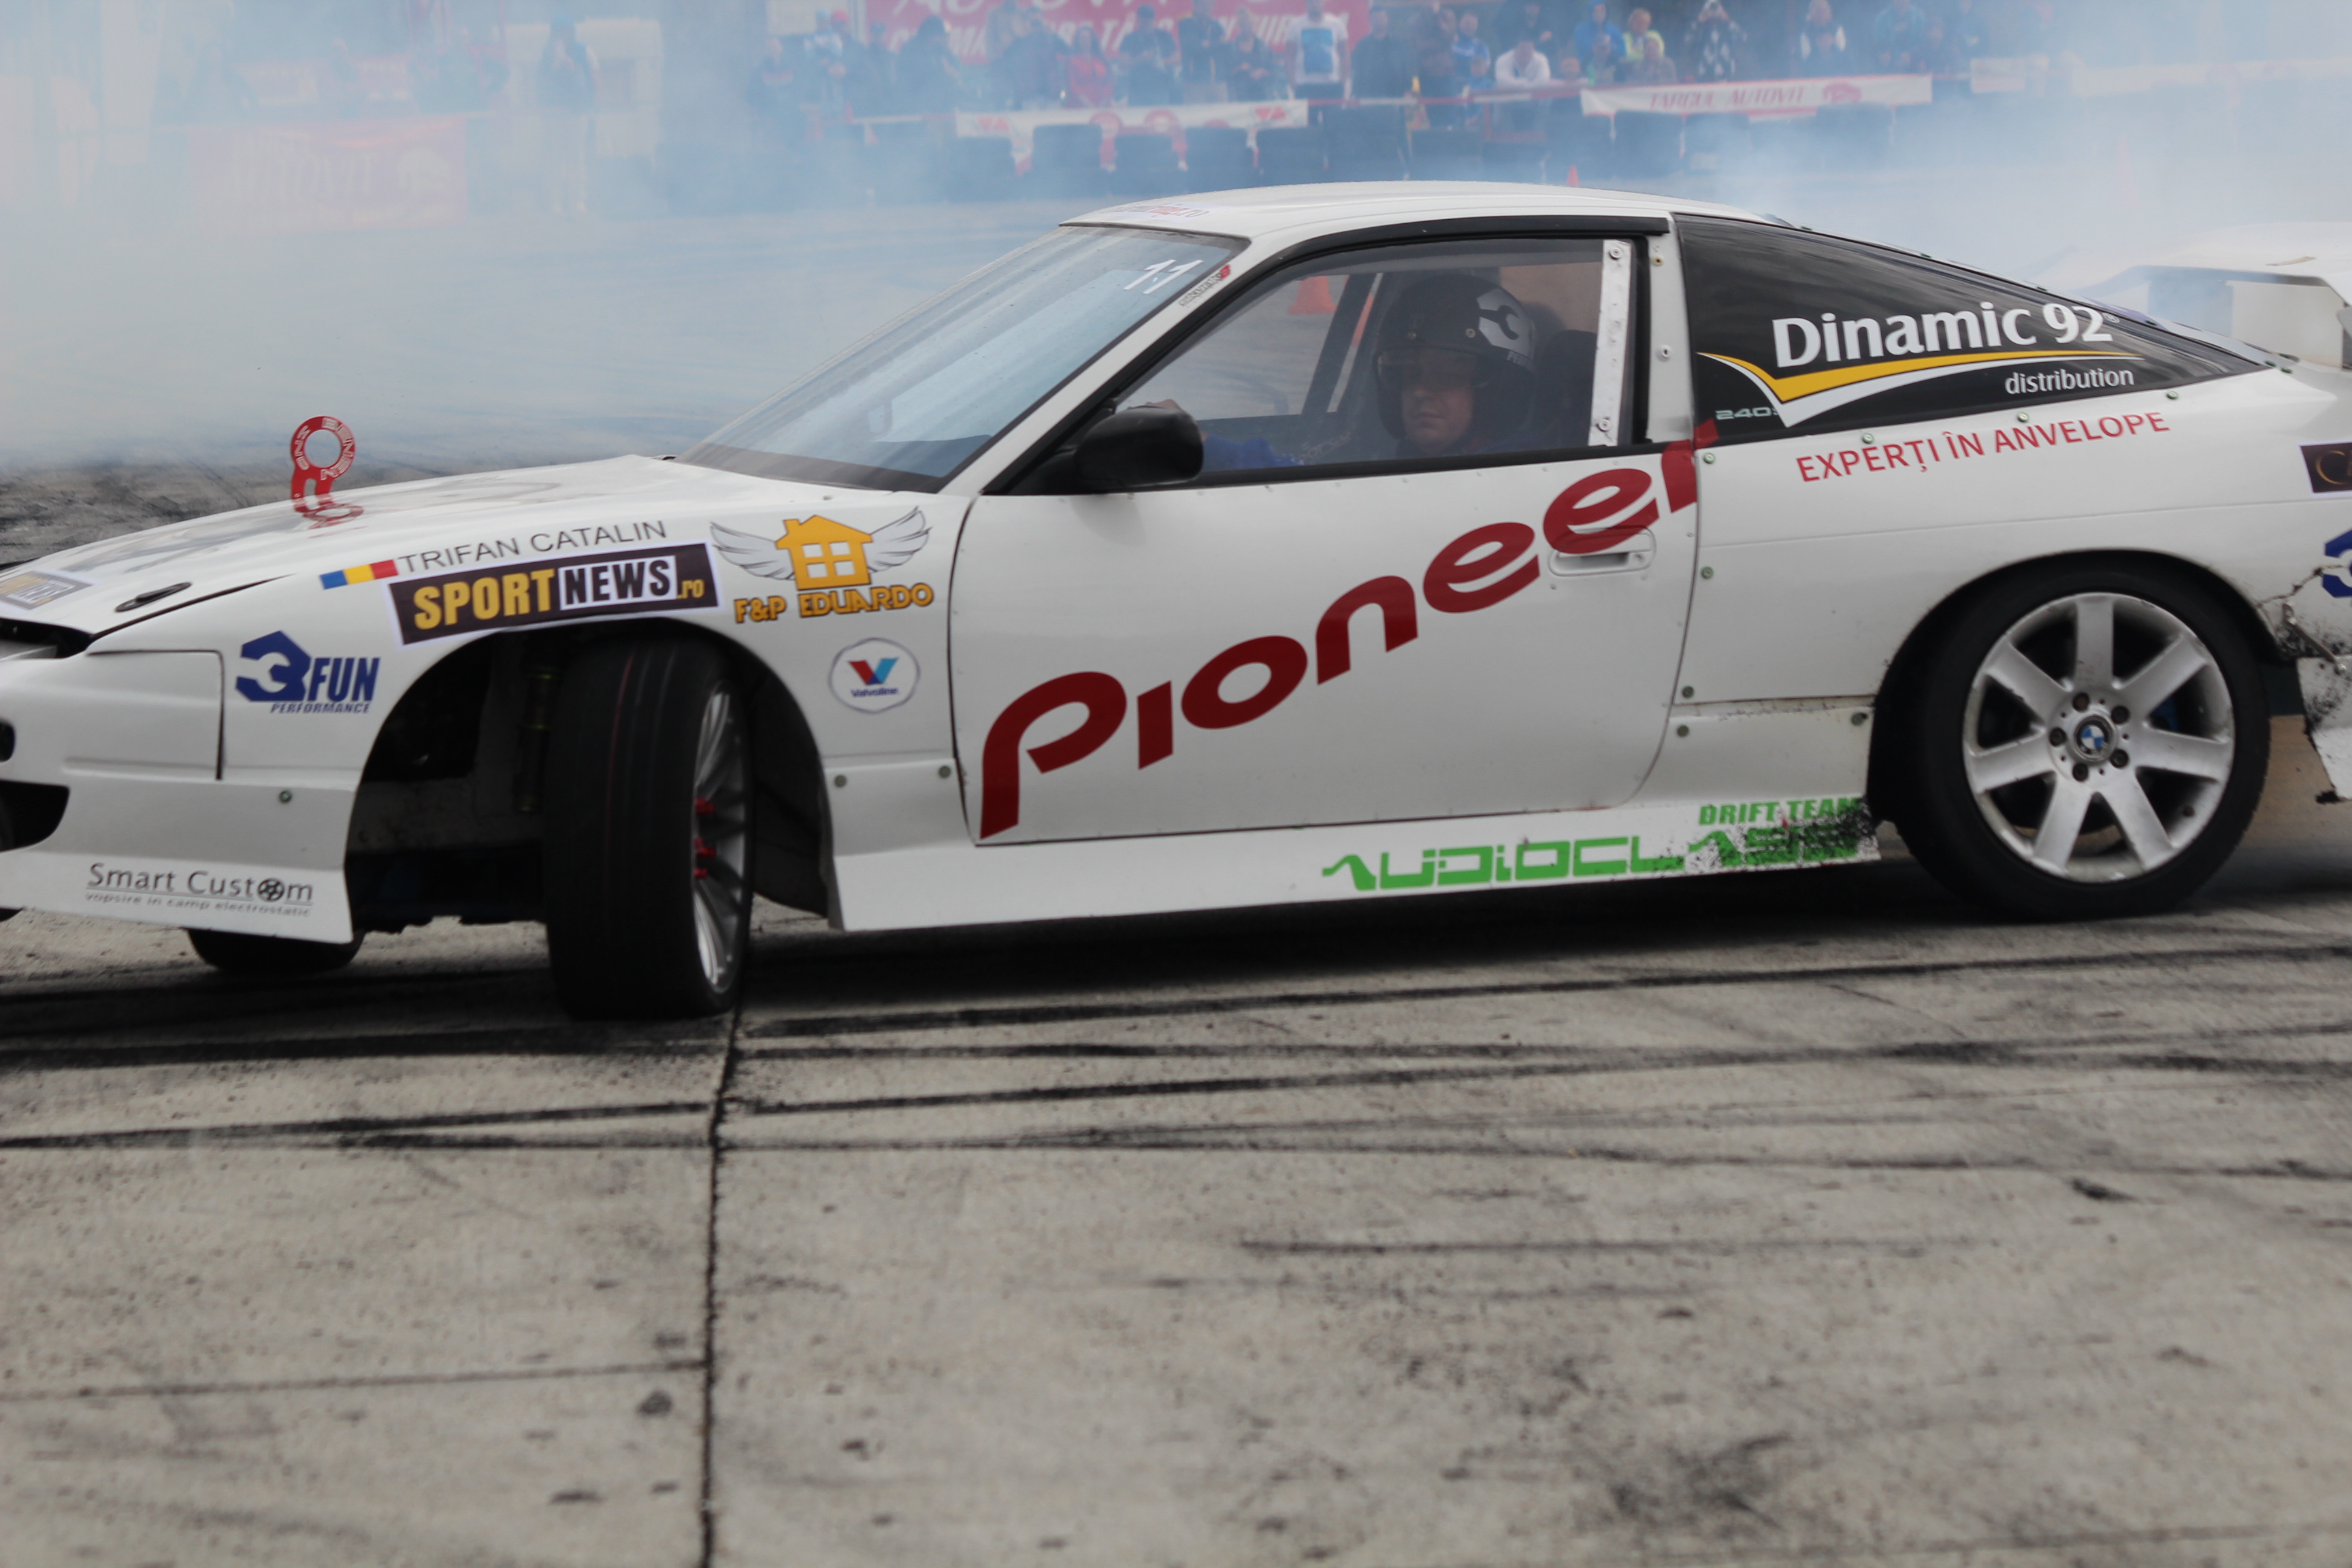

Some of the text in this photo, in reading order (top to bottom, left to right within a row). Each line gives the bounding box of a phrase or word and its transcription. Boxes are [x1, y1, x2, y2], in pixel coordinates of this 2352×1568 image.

[1772, 301, 2037, 368] Dinamic
[2005, 368, 2134, 395] distribution
[1994, 412, 2171, 454] ANVELOPE
[399, 520, 667, 574] TRIFAN CATALIN
[798, 583, 934, 618] EDUARDO
[270, 702, 370, 715] PERFORMANCE
[1699, 802, 1781, 826] DRIFT
[87, 862, 176, 893] Smart
